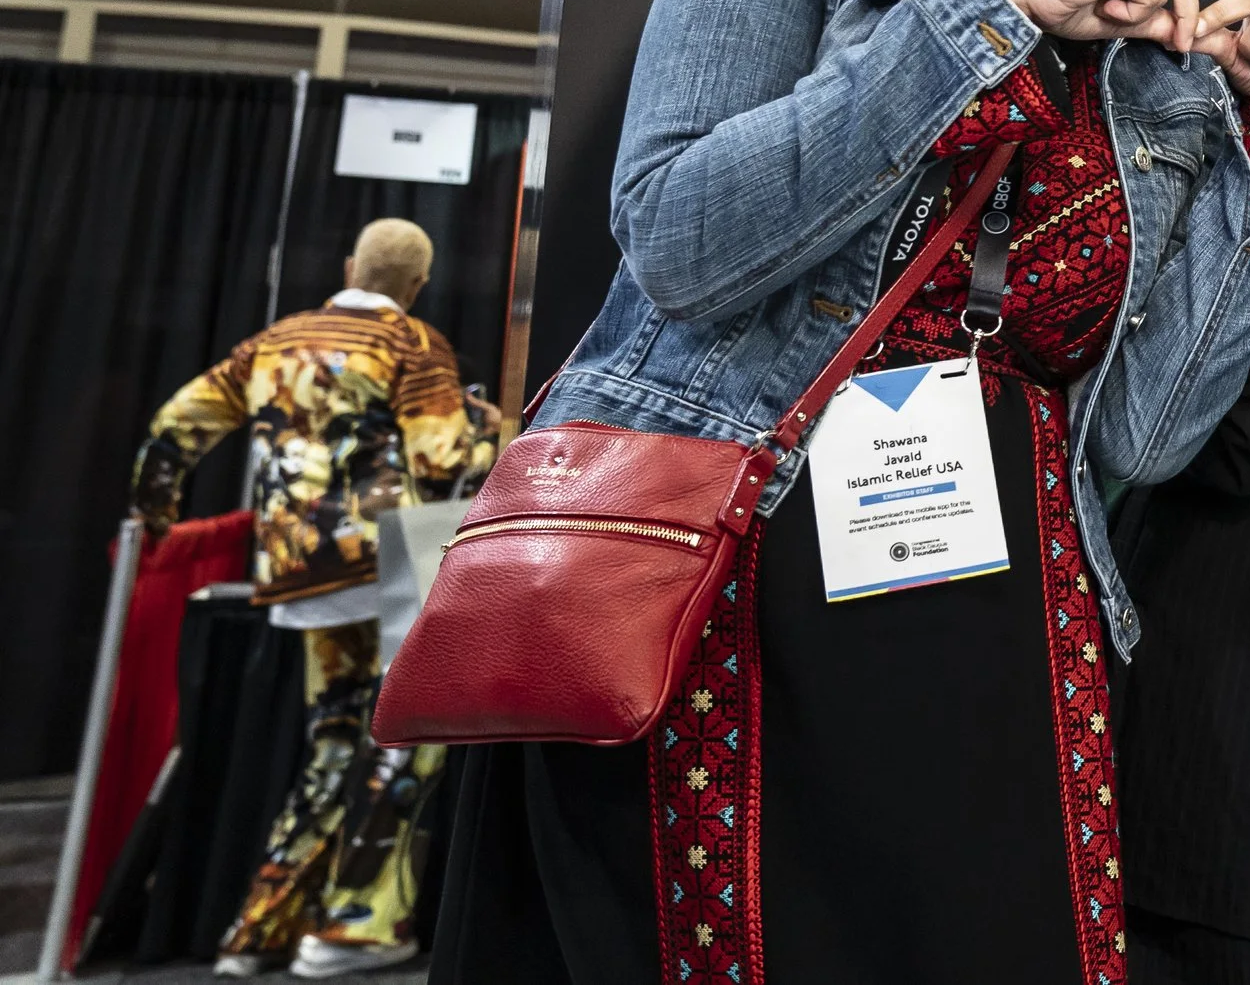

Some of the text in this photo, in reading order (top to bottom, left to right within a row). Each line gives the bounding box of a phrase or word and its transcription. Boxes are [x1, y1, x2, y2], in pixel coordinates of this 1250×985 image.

[992, 176, 1012, 209] CBCF
[892, 195, 934, 261] TOYOTA
[874, 435, 927, 450] Shawana
[884, 451, 922, 466] Javaid
[848, 461, 963, 489] Islamic Relief USA
[850, 517, 870, 525] Please
[868, 521, 897, 530] schedule
[912, 513, 947, 523] conference
[912, 547, 948, 556] Foundation
